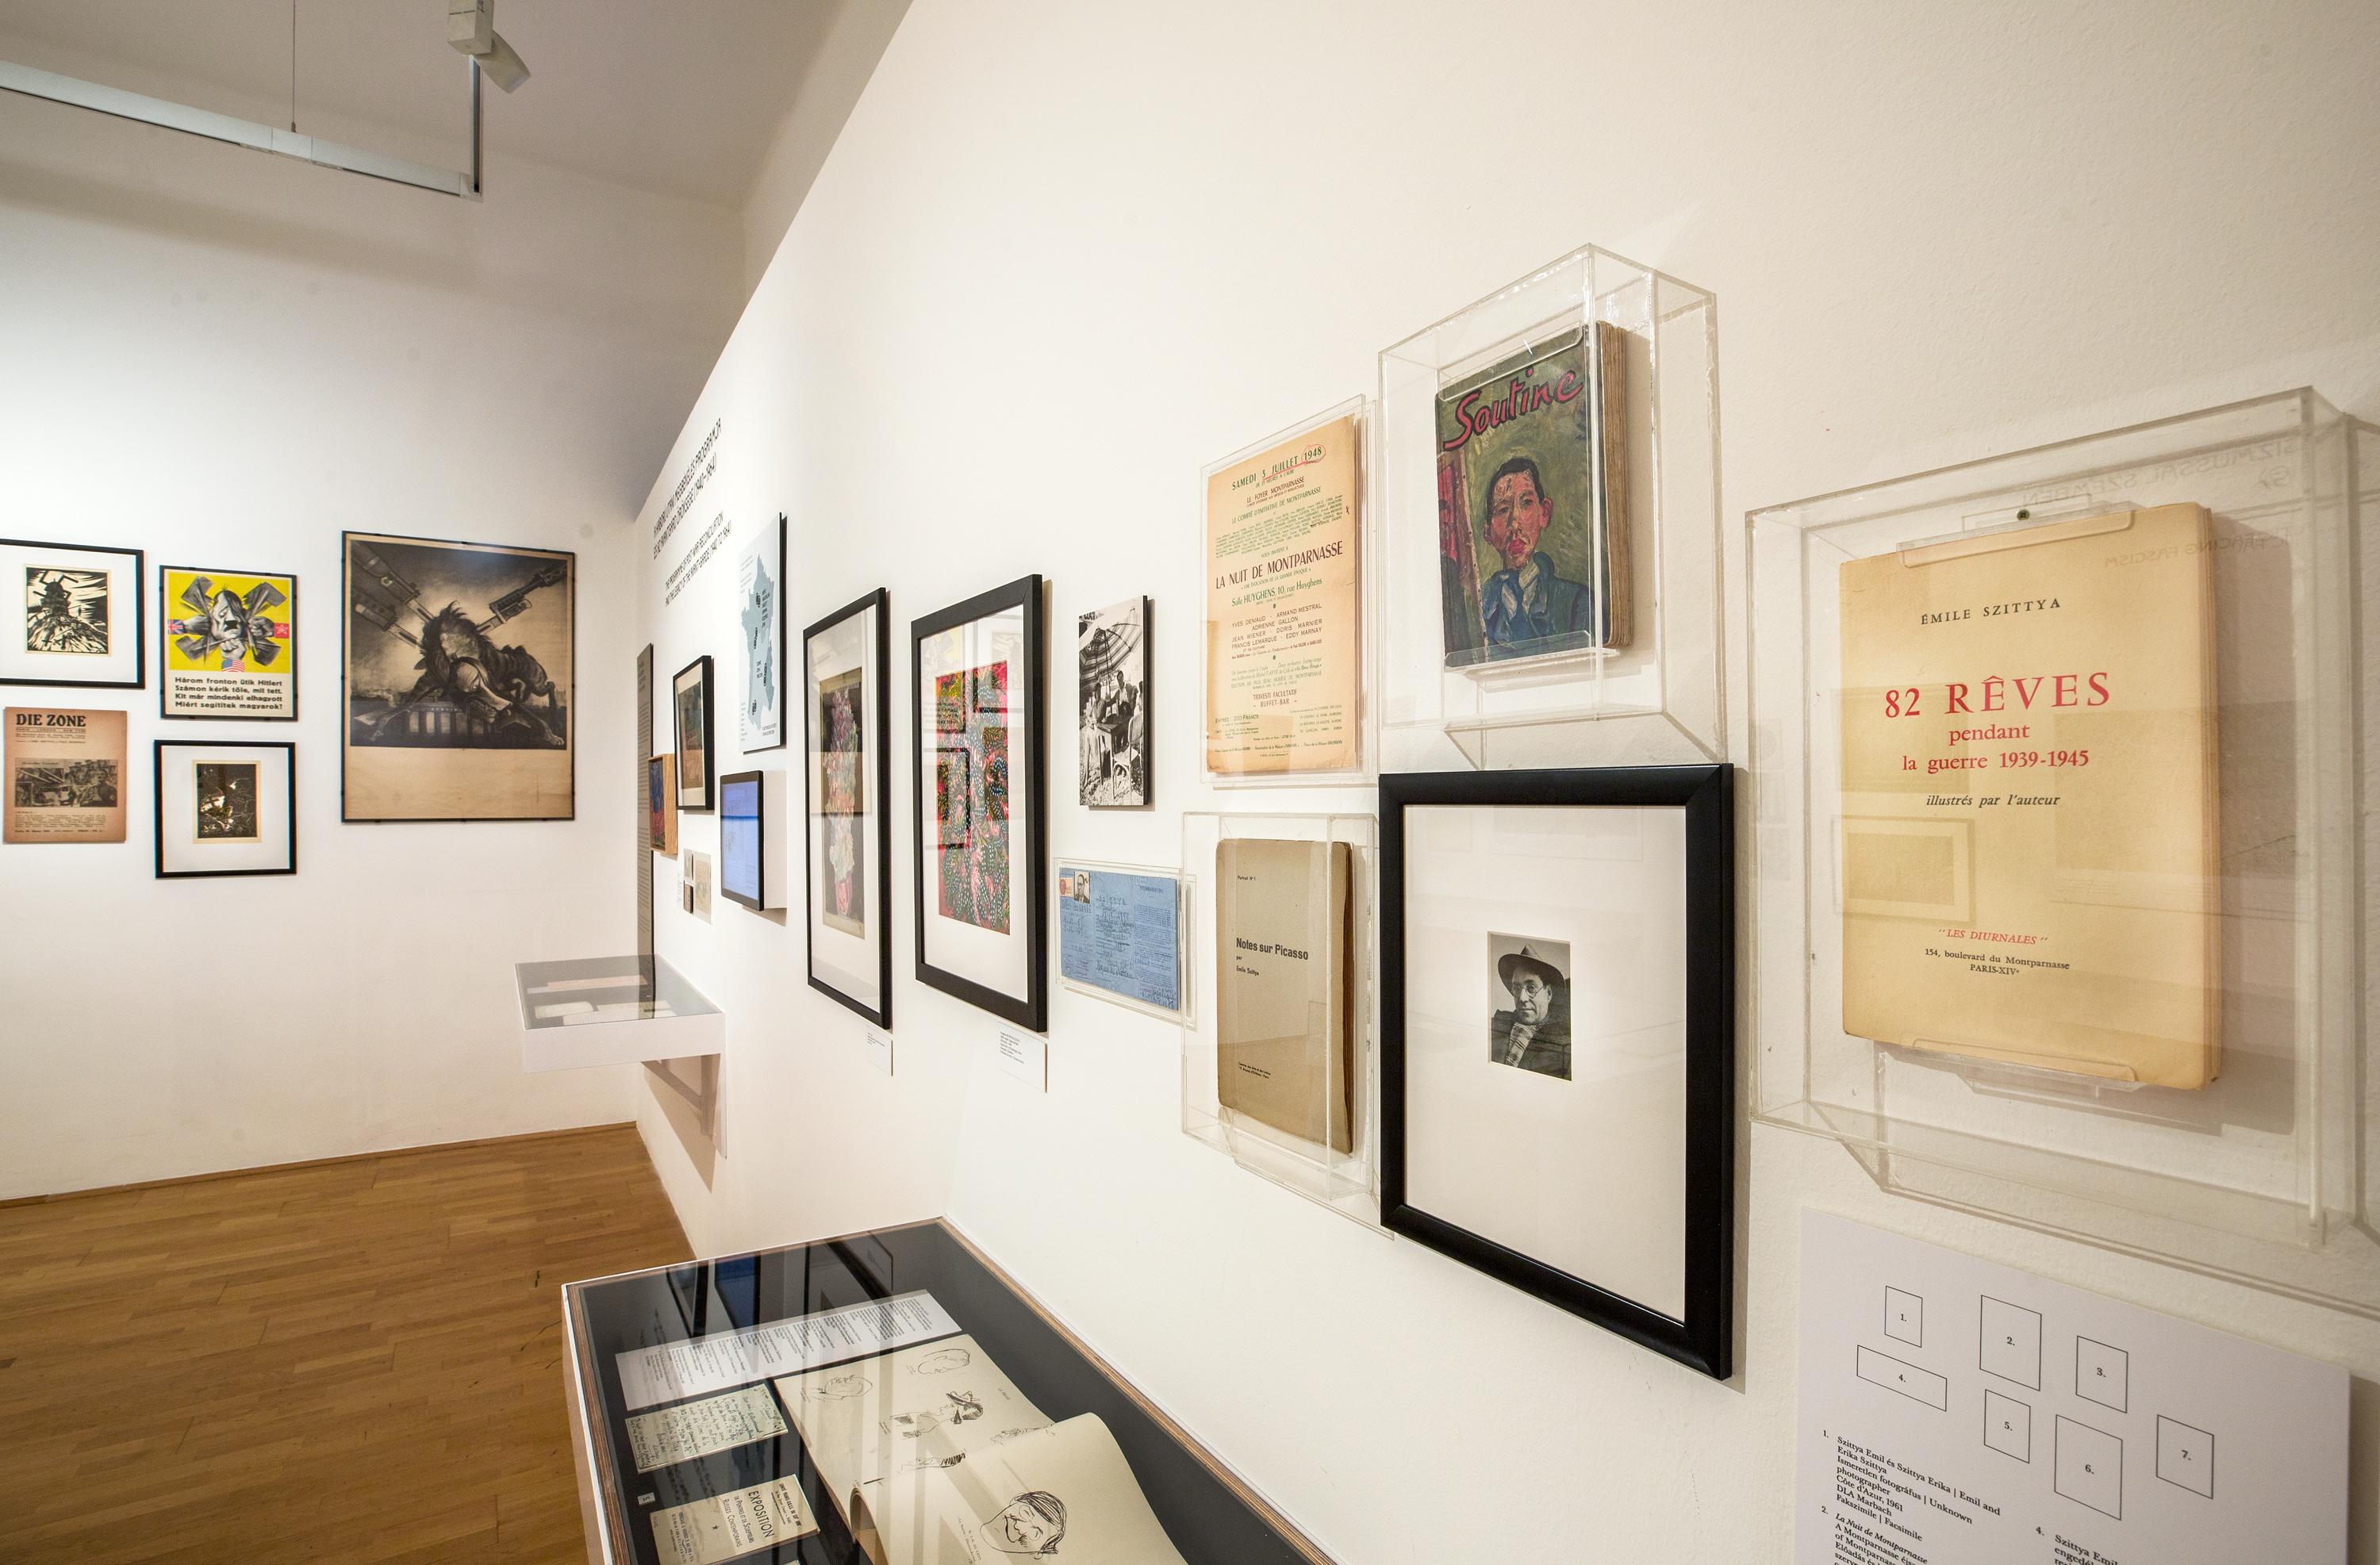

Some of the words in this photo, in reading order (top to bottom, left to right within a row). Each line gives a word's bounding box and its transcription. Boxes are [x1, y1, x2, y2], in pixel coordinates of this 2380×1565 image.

[1442, 366, 1584, 452] Soutine
[1232, 472, 1256, 490] SAMEDI
[1272, 455, 1298, 474] JUILLET
[1303, 445, 1322, 461] 1948
[1254, 489, 1268, 500] FOYER
[1271, 475, 1304, 493] MONTPARNASSE
[1279, 498, 1285, 507] DE
[1287, 485, 1321, 504] MONTPARNASSE
[1215, 575, 1225, 589] LA
[1229, 569, 1247, 585] NUIT
[1252, 564, 1262, 578] DE
[1267, 540, 1342, 573] MONTPARNASSE
[1232, 596, 1242, 607] Salle
[1296, 575, 1322, 591] Huyghens
[1246, 616, 1265, 625] DENIAUD
[1276, 608, 1296, 618] ARMAND
[1298, 602, 1321, 612] MESTRAL
[1252, 620, 1275, 631] ADRIENNE
[1278, 615, 1298, 625] GALLON
[1921, 608, 1971, 625] ÉMILE
[1983, 598, 2061, 617] SZITTYA
[1246, 630, 1265, 639] WIENER
[1298, 619, 1322, 629] MARNIER
[1252, 635, 1276, 645] LEMARQUE
[1300, 627, 1322, 635] MARNAY
[1260, 698, 1289, 707] BUFFET-BAR
[1273, 689, 1296, 697] FACULTATIF
[1885, 687, 1921, 718] 82
[1944, 672, 2110, 714] RÊVES
[16, 714, 42, 725] DIE
[46, 714, 86, 727] ZONE
[1948, 723, 2030, 746] pendant
[1902, 755, 1917, 770] la
[1928, 757, 1987, 774] guerre
[1999, 750, 2090, 768] 1939-1945
[1926, 795, 1972, 806] illustrés
[1979, 797, 2001, 808] par
[2007, 795, 2060, 806] l'auteur
[1236, 938, 1258, 952] Notes
[1259, 943, 1273, 954] sur
[1274, 943, 1309, 961] Picasso
[1925, 949, 1940, 957] 154,
[1944, 950, 1985, 961] boulevard
[2006, 957, 2070, 969] Montparnasse
[1900, 1314, 1907, 1322] 1.
[2007, 1336, 2015, 1346] 2.
[1898, 1374, 1906, 1383] 4.
[2096, 1367, 2106, 1378] 3.
[2004, 1421, 2012, 1431] 5.
[1837, 1446, 1858, 1461] Erika
[1860, 1456, 1887, 1475] Szittya
[2182, 1449, 2191, 1461] 7.
[1837, 1436, 1864, 1454] Szittya
[1866, 1448, 1885, 1463] Emil
[1887, 1458, 1894, 1467] és
[1897, 1463, 1925, 1482] Szittya
[1928, 1476, 1951, 1493] Erika
[1960, 1491, 1980, 1506] Emil
[1983, 1502, 2001, 1516] and
[2085, 1464, 2094, 1475] 6.
[1837, 1467, 1891, 1496] photographer
[1837, 1456, 1878, 1480] Ismeretlen
[1880, 1476, 1921, 1500] fotográfus
[1929, 1498, 1973, 1525] Unknown
[1837, 1475, 1855, 1490] Côte
[1856, 1483, 1884, 1504] d'Azur,
[1887, 1498, 1903, 1512] 1961
[1837, 1485, 1855, 1498] DLA
[1856, 1493, 1892, 1517] Marbach
[747, 1490, 775, 1537] EXPOSITION
[1837, 1494, 1877, 1519] Fakszimile
[1885, 1517, 1922, 1542] Facsimile
[1821, 1506, 1828, 1514] 2.
[1836, 1513, 1845, 1523] La
[1846, 1519, 1863, 1532] Nuit
[1864, 1528, 1873, 1536] de
[1875, 1534, 1928, 1564] Montparnasse
[1844, 1528, 1898, 1561] Montparnasse
[2036, 1527, 2044, 1536] 4.
[2056, 1534, 2090, 1556] Szittya
[1836, 1542, 1864, 1563] Előadás
